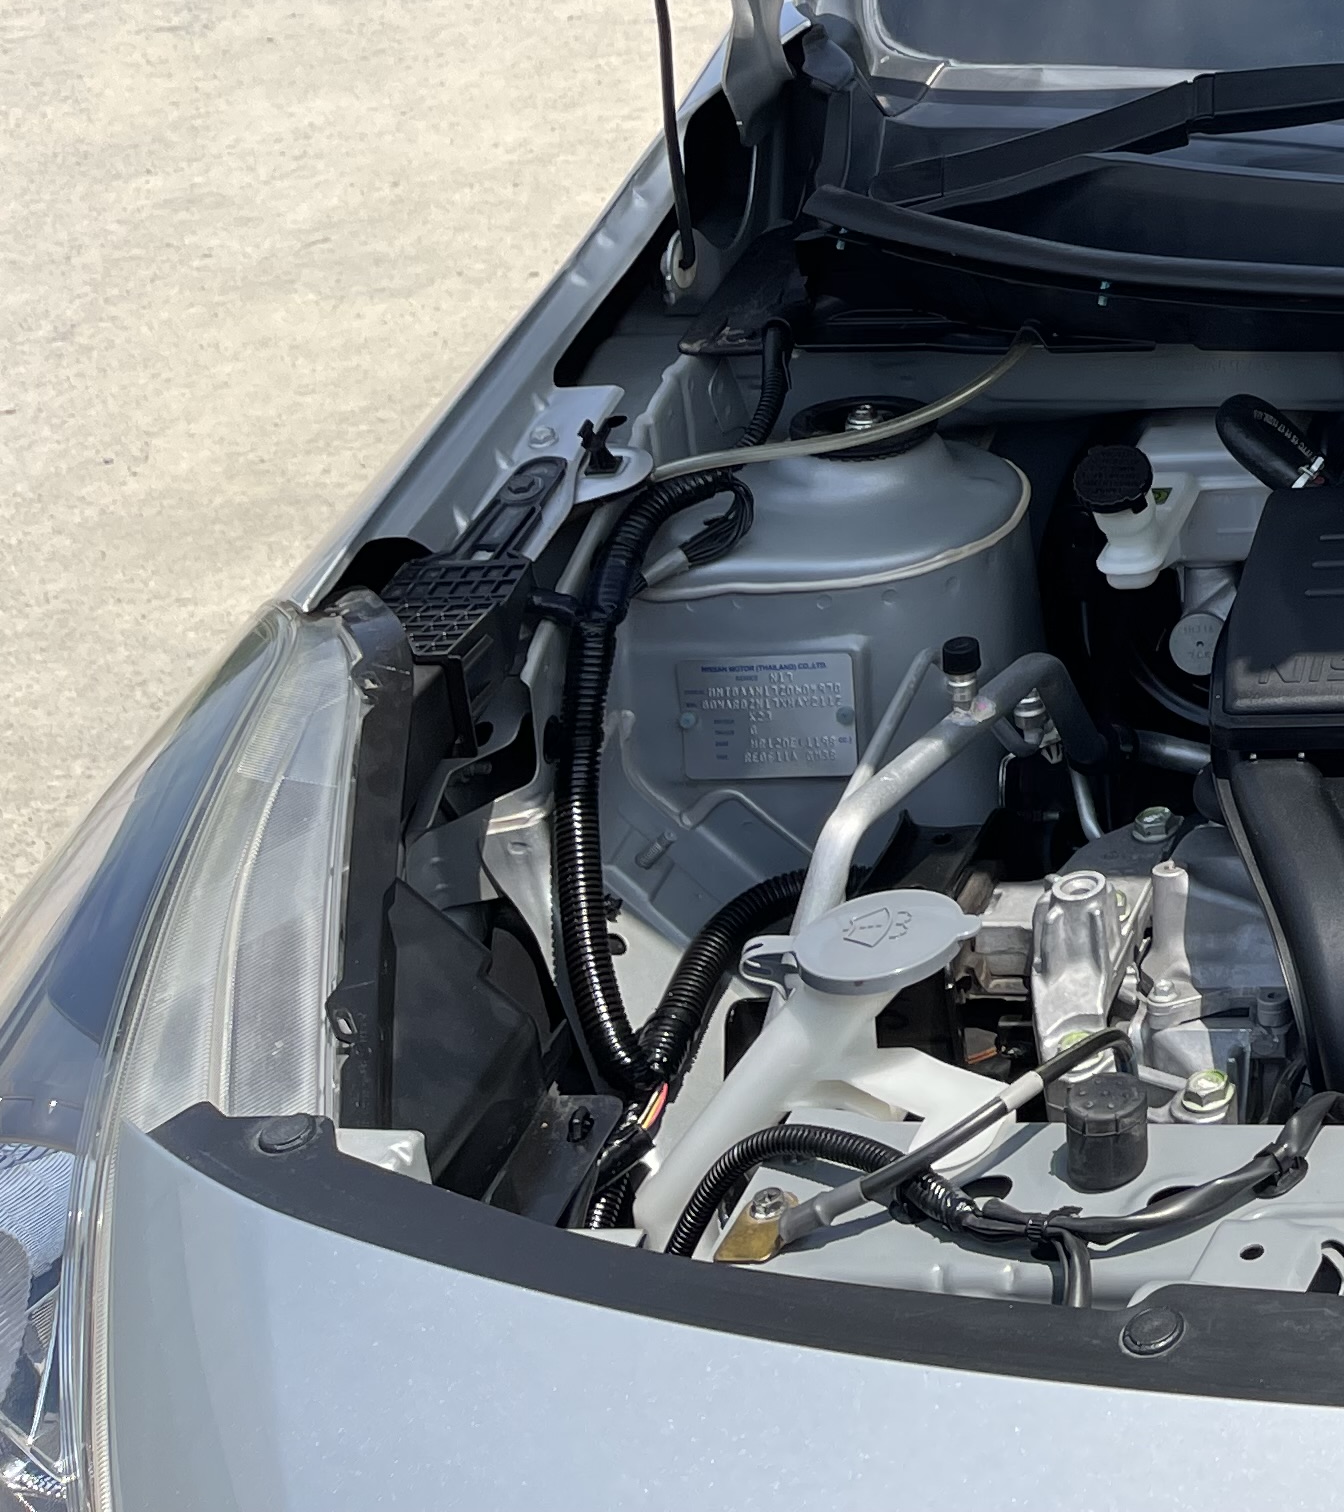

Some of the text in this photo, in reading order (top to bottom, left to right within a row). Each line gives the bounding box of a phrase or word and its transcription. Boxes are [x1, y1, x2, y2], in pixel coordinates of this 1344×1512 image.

[728, 664, 754, 672] MOTOR
[756, 664, 796, 672] (THAILAND)
[768, 672, 794, 682] N17
